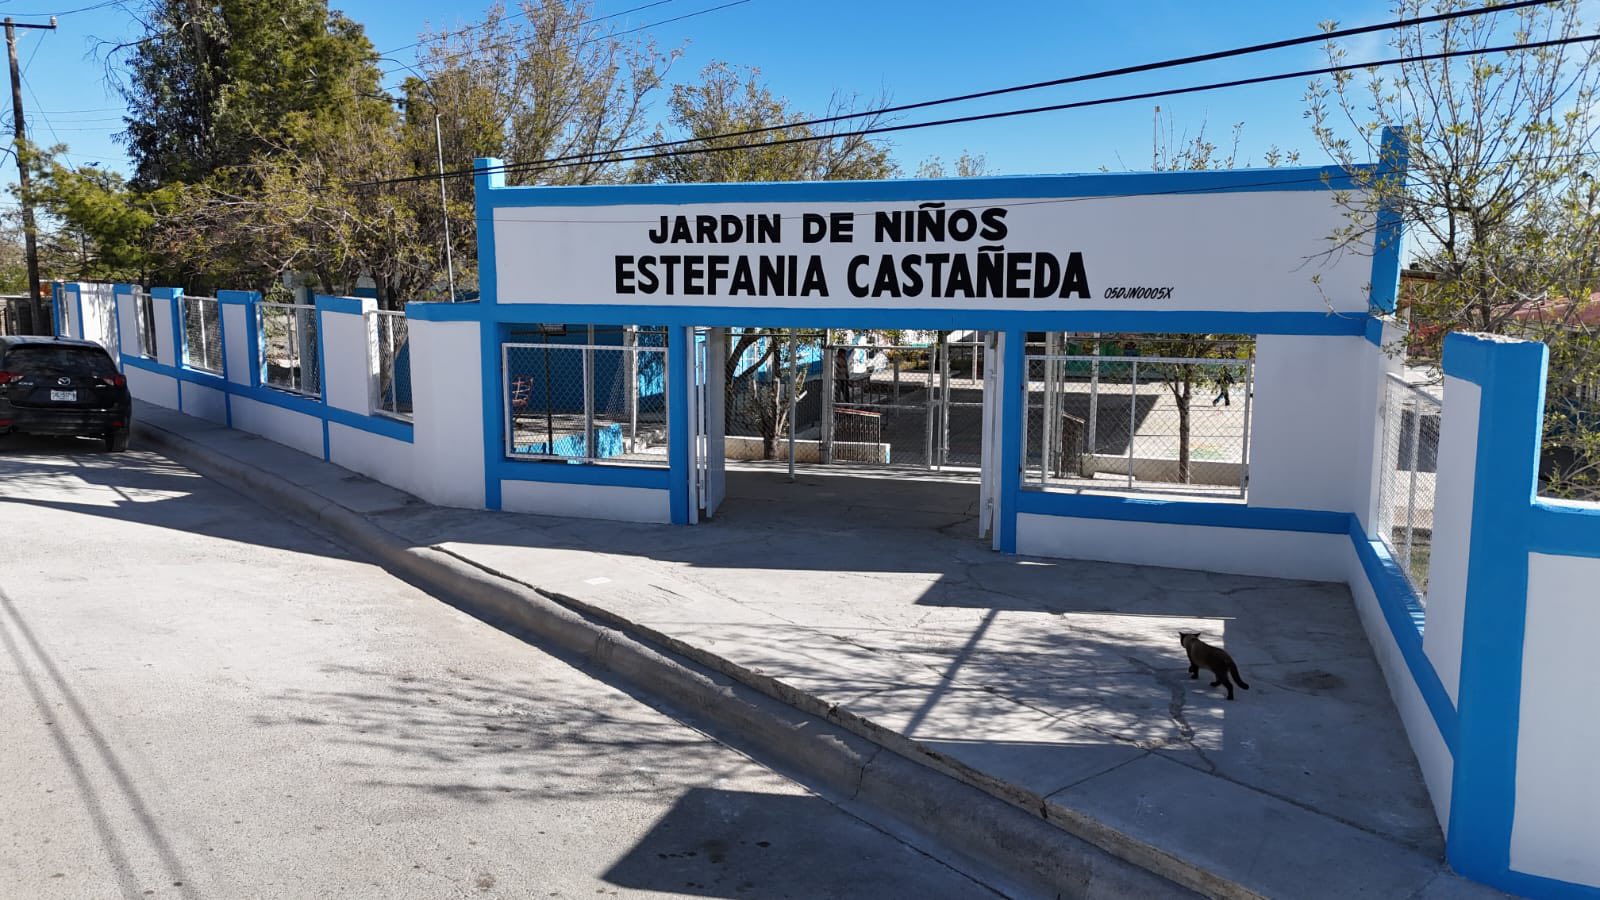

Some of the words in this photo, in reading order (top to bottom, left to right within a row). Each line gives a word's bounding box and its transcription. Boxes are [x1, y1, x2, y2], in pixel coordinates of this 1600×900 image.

[648, 213, 781, 244] JARDIN
[802, 212, 854, 243] DE
[874, 203, 1008, 243] NIÑOS
[614, 254, 830, 298] ESTEFANIA
[847, 245, 1092, 299] CASTAÑEDA
[1103, 286, 1175, 300] 05DJN0005X
